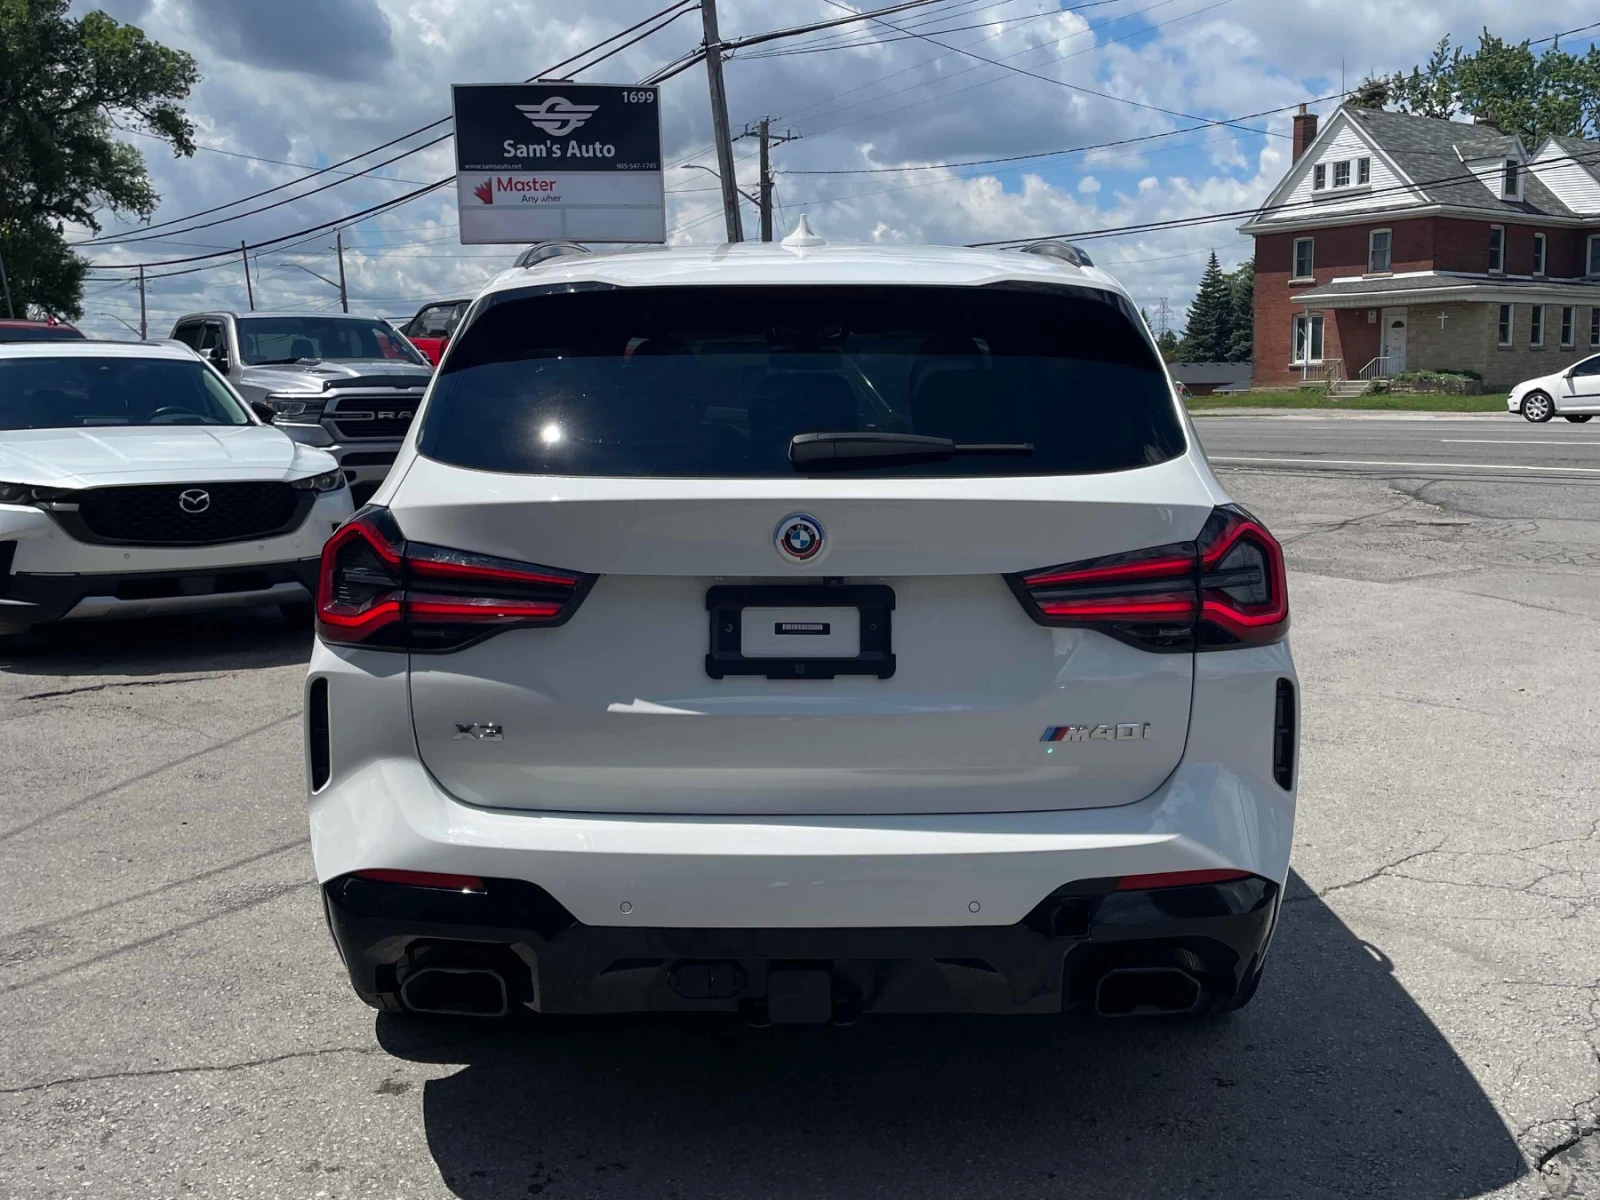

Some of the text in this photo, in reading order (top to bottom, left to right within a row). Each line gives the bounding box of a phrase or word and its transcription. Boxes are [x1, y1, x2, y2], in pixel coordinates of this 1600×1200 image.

[622, 91, 654, 103] 1699
[503, 140, 616, 158] Sam's Auto
[497, 177, 556, 192] Master
[521, 194, 539, 204] Any
[378, 411, 413, 419] RA
[787, 524, 814, 536] BMW
[452, 722, 504, 741] X3
